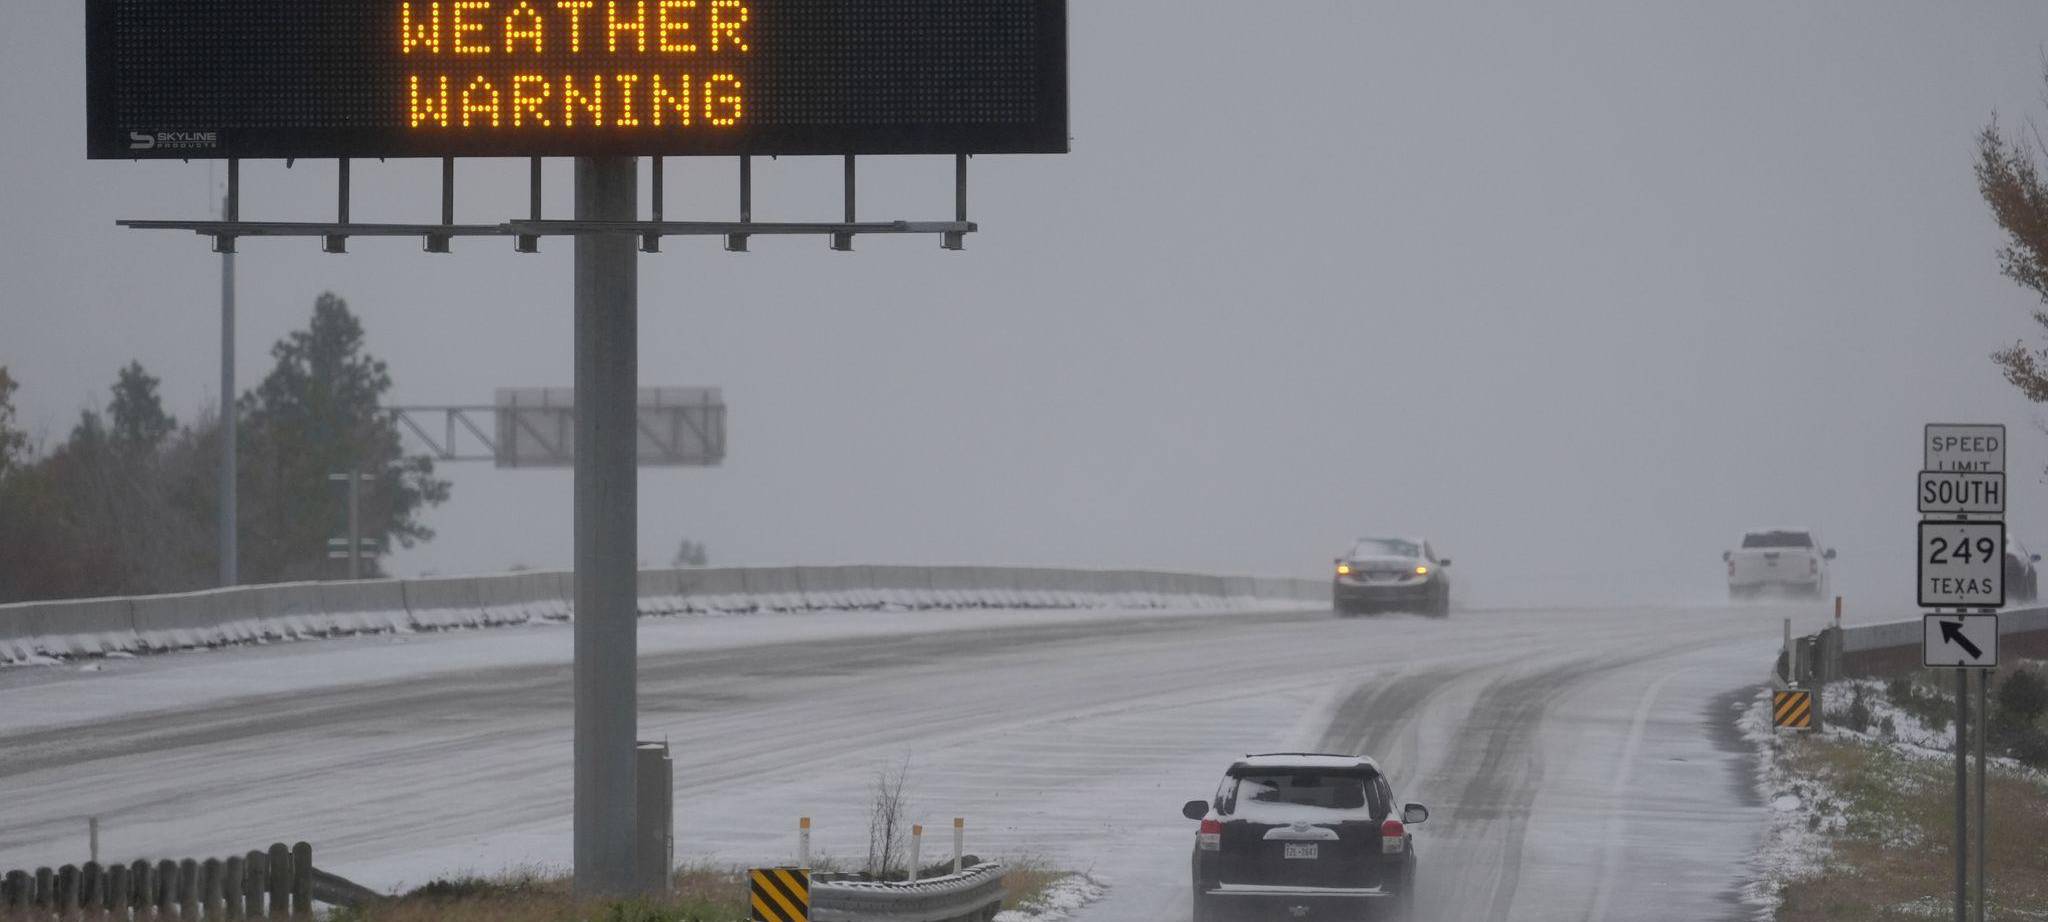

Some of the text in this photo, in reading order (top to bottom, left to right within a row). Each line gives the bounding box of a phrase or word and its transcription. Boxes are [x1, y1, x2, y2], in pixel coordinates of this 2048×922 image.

[402, 1, 748, 53] WEATHER
[411, 74, 741, 127] WARNING
[157, 132, 216, 141] SKYLINE
[1932, 436, 1999, 452] SPEED
[1923, 480, 1998, 504] SOUTH
[1930, 537, 1994, 564] 249
[1930, 578, 1993, 594] TEXAS
